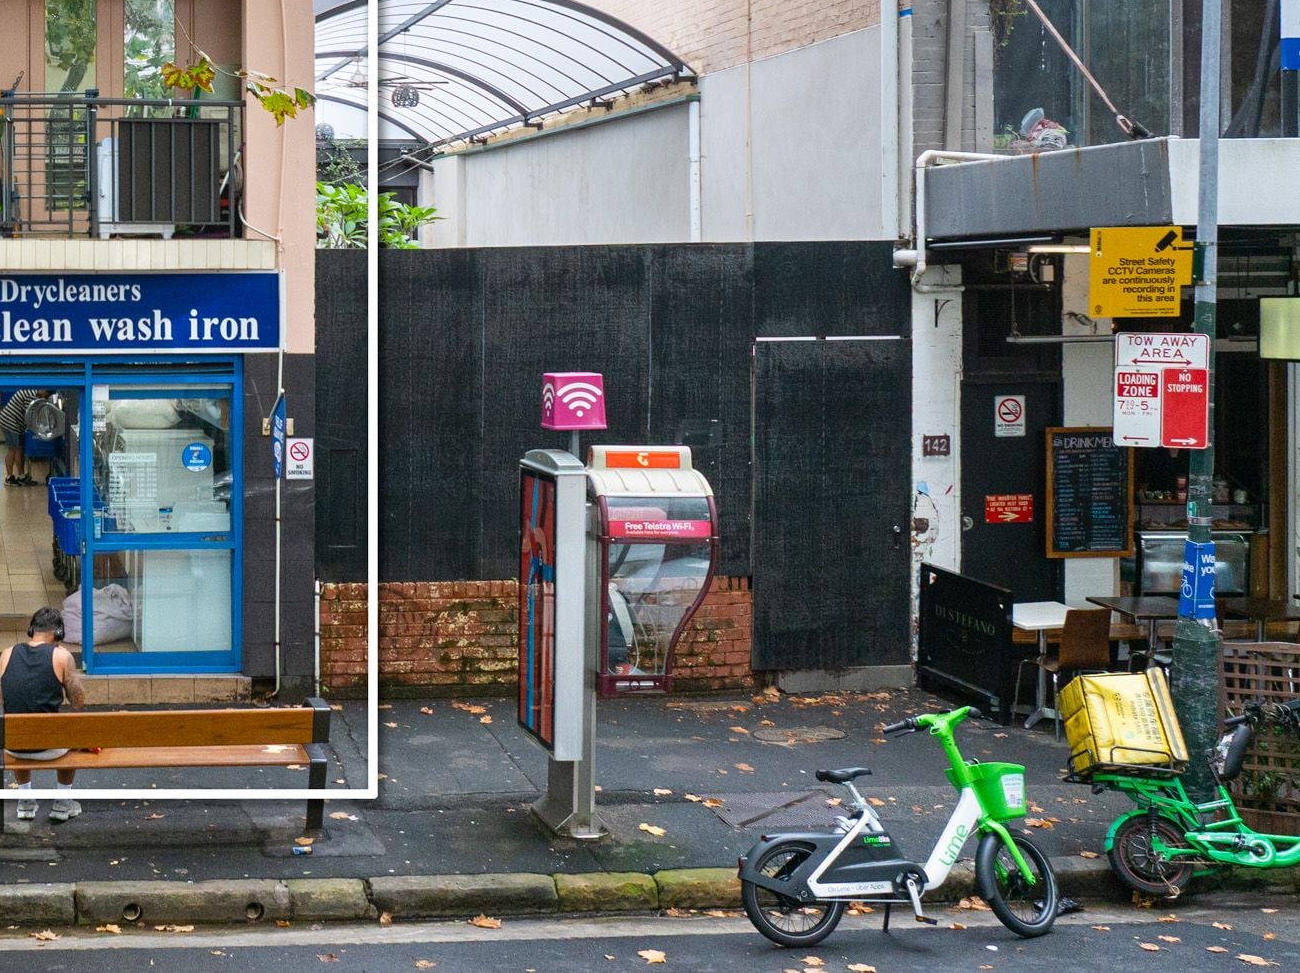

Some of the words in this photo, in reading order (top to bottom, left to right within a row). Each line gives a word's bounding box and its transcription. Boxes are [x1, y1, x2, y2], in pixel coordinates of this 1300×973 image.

[1119, 258, 1145, 266] Street
[1147, 257, 1176, 266] Safety
[1108, 267, 1135, 275] CCTV
[1136, 267, 1176, 275] Cameras
[1119, 276, 1175, 286] continuously
[0, 279, 142, 309] Drycleaners
[1123, 286, 1165, 295] recording
[1167, 285, 1175, 293] in
[1137, 294, 1153, 302] this
[88, 309, 174, 343] wash
[189, 308, 260, 341] iron
[1127, 336, 1153, 346] TOW
[1161, 337, 1197, 347] AWAY
[1140, 347, 1184, 359] AREA
[1119, 374, 1156, 385] LOADING
[1178, 373, 1192, 382] NO
[1122, 385, 1153, 397] ZONE
[1167, 384, 1203, 393] STOPPING
[925, 438, 947, 452] 142
[625, 522, 643, 530] Free
[643, 522, 672, 530] Telstra
[938, 824, 969, 867] Lime
